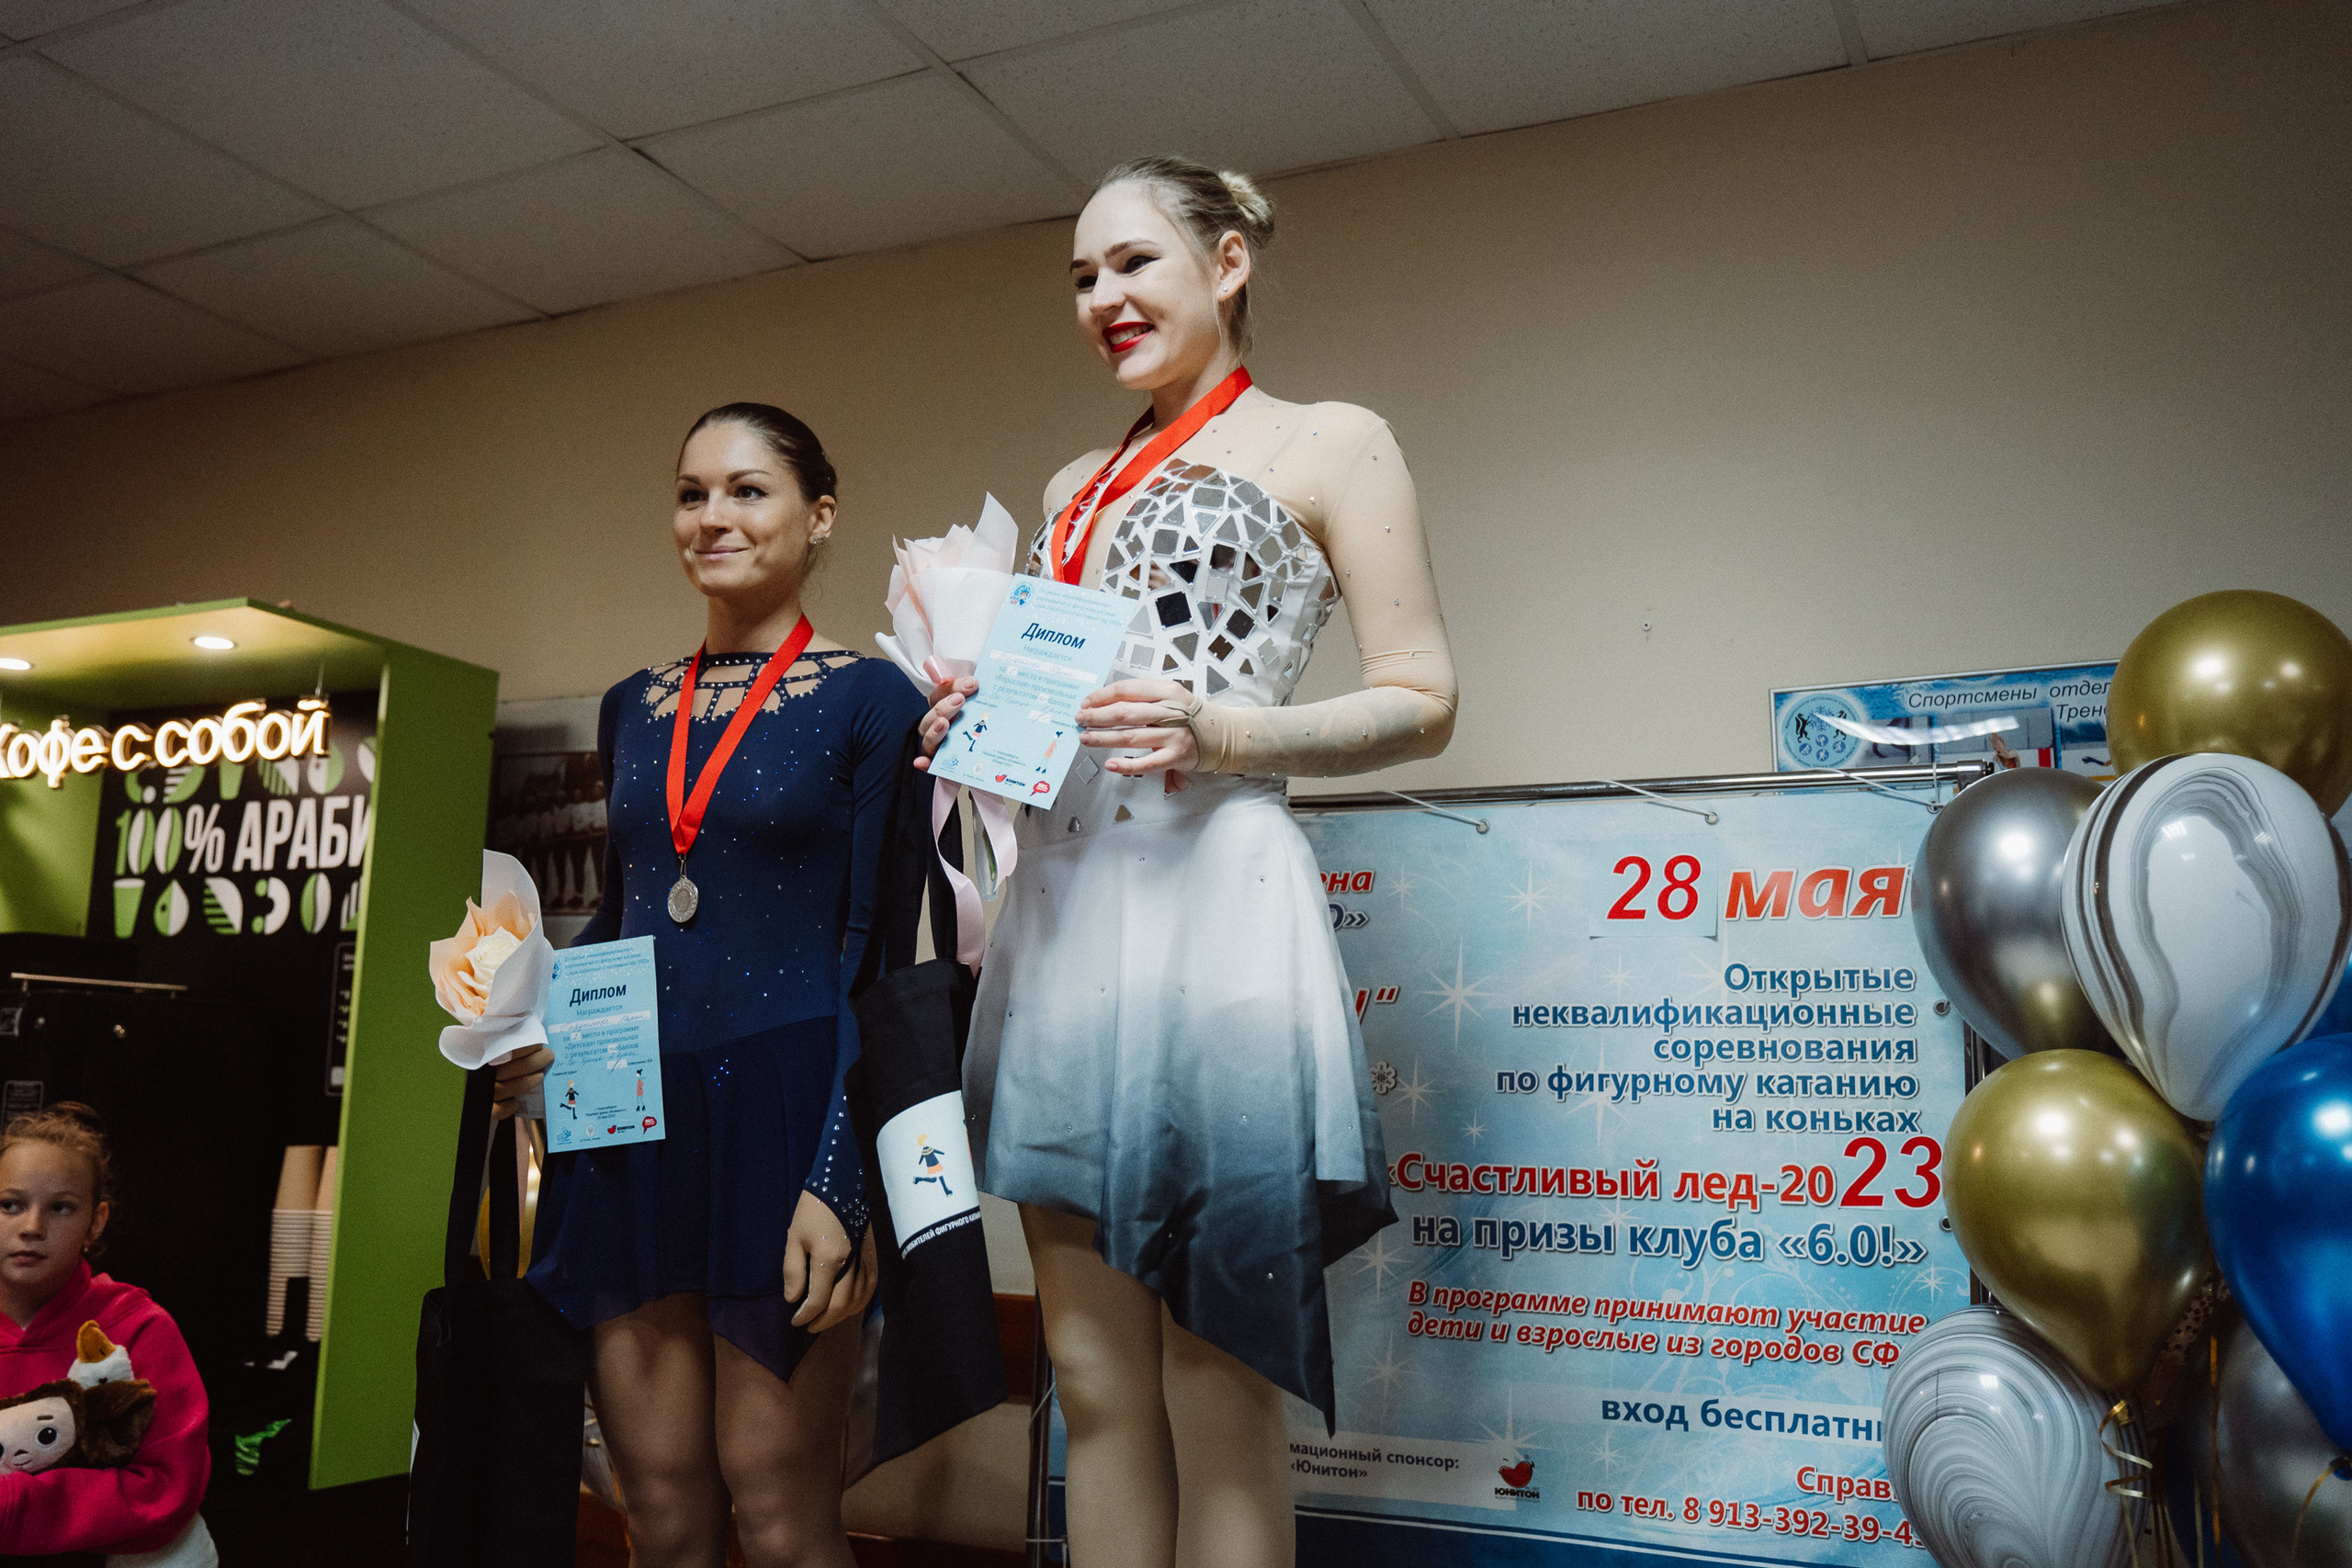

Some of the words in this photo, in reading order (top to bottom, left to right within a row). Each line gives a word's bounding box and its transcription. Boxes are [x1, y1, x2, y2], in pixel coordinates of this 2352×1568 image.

[1021, 622, 1086, 649] Диплом
[1023, 644, 1073, 661] Награждается
[998, 685, 1039, 701] результатом
[1018, 671, 1037, 682] место
[1044, 677, 1080, 692] программе
[1908, 686, 2037, 710] Спортсмены
[2056, 704, 2107, 723] Трен
[112, 725, 153, 772] с
[155, 698, 332, 768] собой
[115, 803, 226, 875] 100%
[232, 795, 371, 873] АРАБИ
[1607, 854, 1702, 920] 28
[1724, 866, 1907, 920] мая
[1724, 963, 1916, 999] Открытые
[570, 984, 627, 1008] Диплом
[576, 1005, 624, 1017] Награждается
[1512, 998, 1916, 1033] неквалификационные
[596, 1034, 639, 1045] произвольная
[605, 1025, 639, 1036] программе
[570, 1048, 608, 1059] результатом
[617, 1043, 639, 1052] баллов
[1654, 1037, 1917, 1068] соревнования
[1496, 1070, 1539, 1093] по
[1547, 1065, 1747, 1103] фигурному
[1757, 1073, 1918, 1099] катанию
[1713, 1108, 1754, 1131] на
[1766, 1109, 1922, 1134] коньках
[935, 1215, 970, 1235] ФИГУРНОГО
[1412, 1214, 1461, 1245] на
[1474, 1218, 1614, 1259] призы
[1629, 1217, 1764, 1268] клуба
[1777, 1223, 1928, 1267] «6.0!»
[1408, 1280, 1427, 1304] В
[1432, 1287, 1588, 1316] программе
[1593, 1297, 1779, 1326] принимают
[1784, 1307, 1928, 1335] участие
[1408, 1311, 1482, 1340] дети
[1490, 1324, 1509, 1342] и
[1516, 1324, 1657, 1353] взрослые
[1666, 1334, 1702, 1355] из
[1710, 1336, 1842, 1366] городов
[1601, 1400, 1689, 1432] вход
[1289, 1442, 1382, 1463] мационный
[1386, 1452, 1460, 1472] спонсор:
[1494, 1487, 1540, 1499] ЮНИТОН
[1797, 1466, 1897, 1503] Справ
[1577, 1490, 1611, 1512] по
[1621, 1495, 1673, 1521] тел.
[1683, 1496, 1700, 1522] 8
